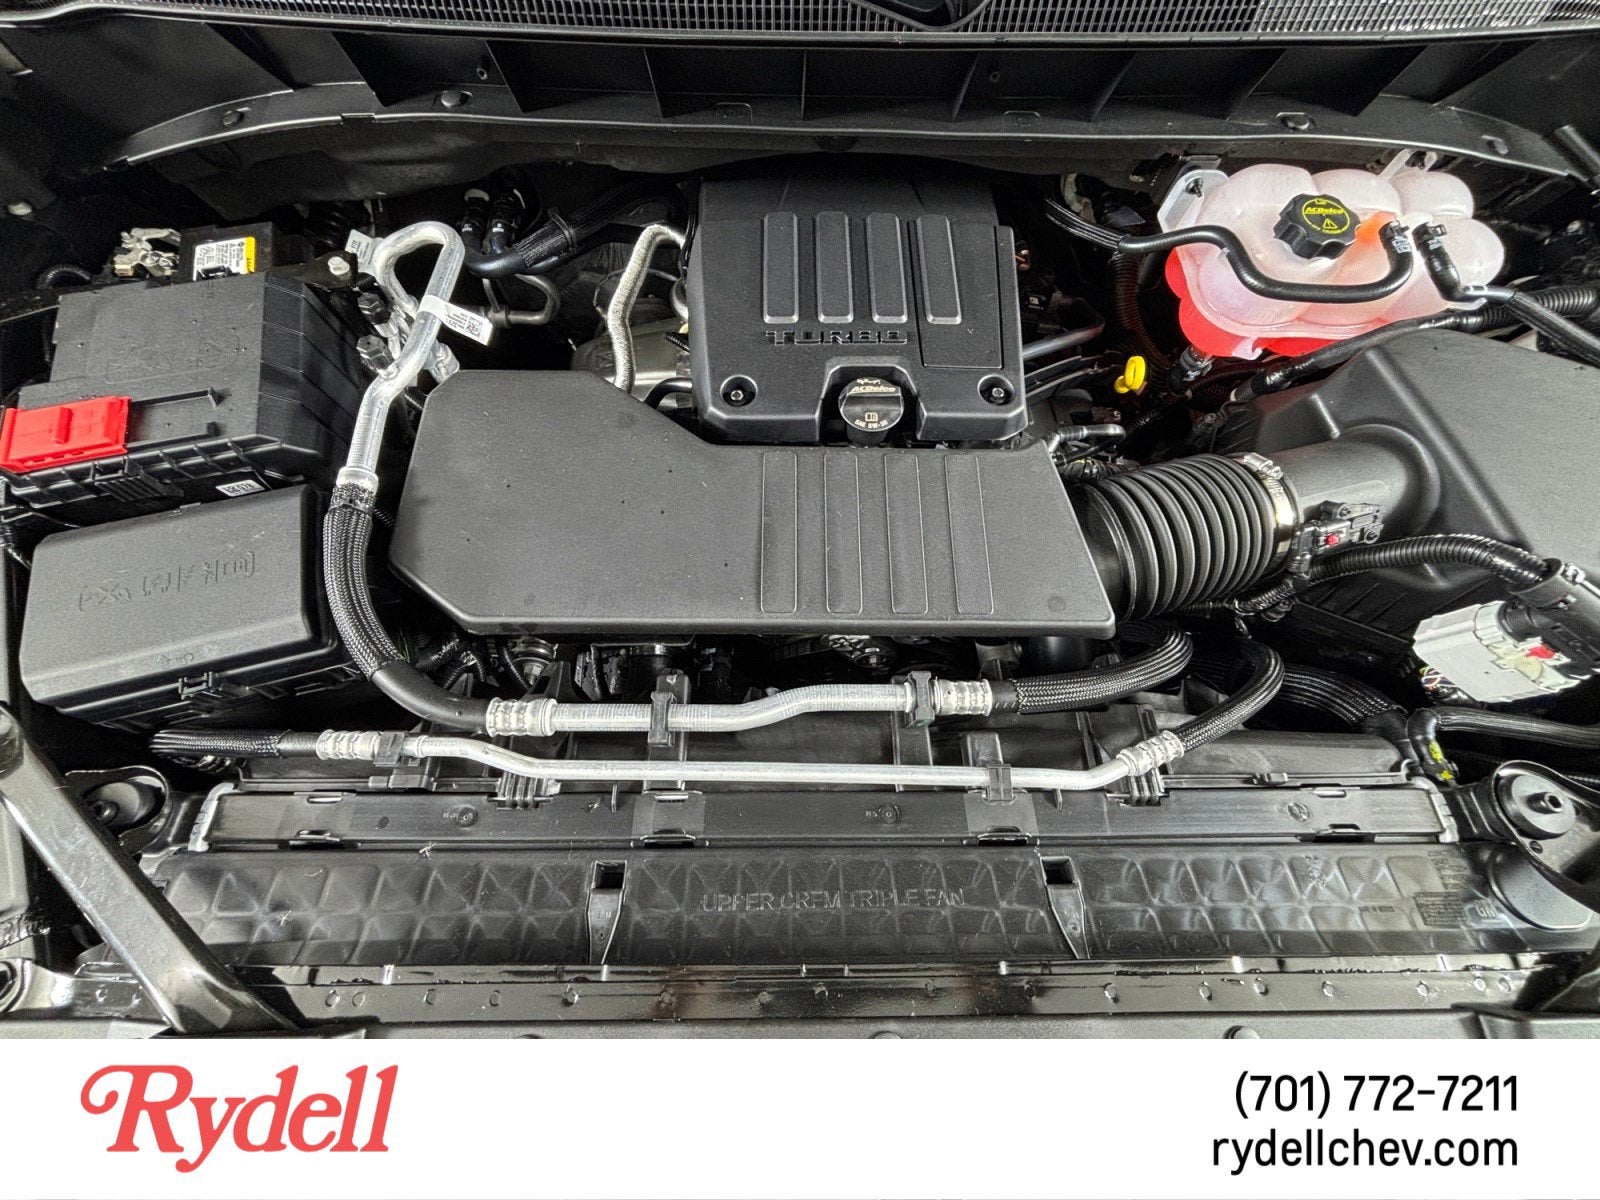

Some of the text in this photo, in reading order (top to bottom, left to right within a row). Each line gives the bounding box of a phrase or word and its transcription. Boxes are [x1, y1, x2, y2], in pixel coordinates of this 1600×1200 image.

[765, 331, 907, 345] TURBO
[851, 385, 896, 394] ACDelco
[702, 892, 774, 912] UPPER
[923, 887, 965, 906] FAN
